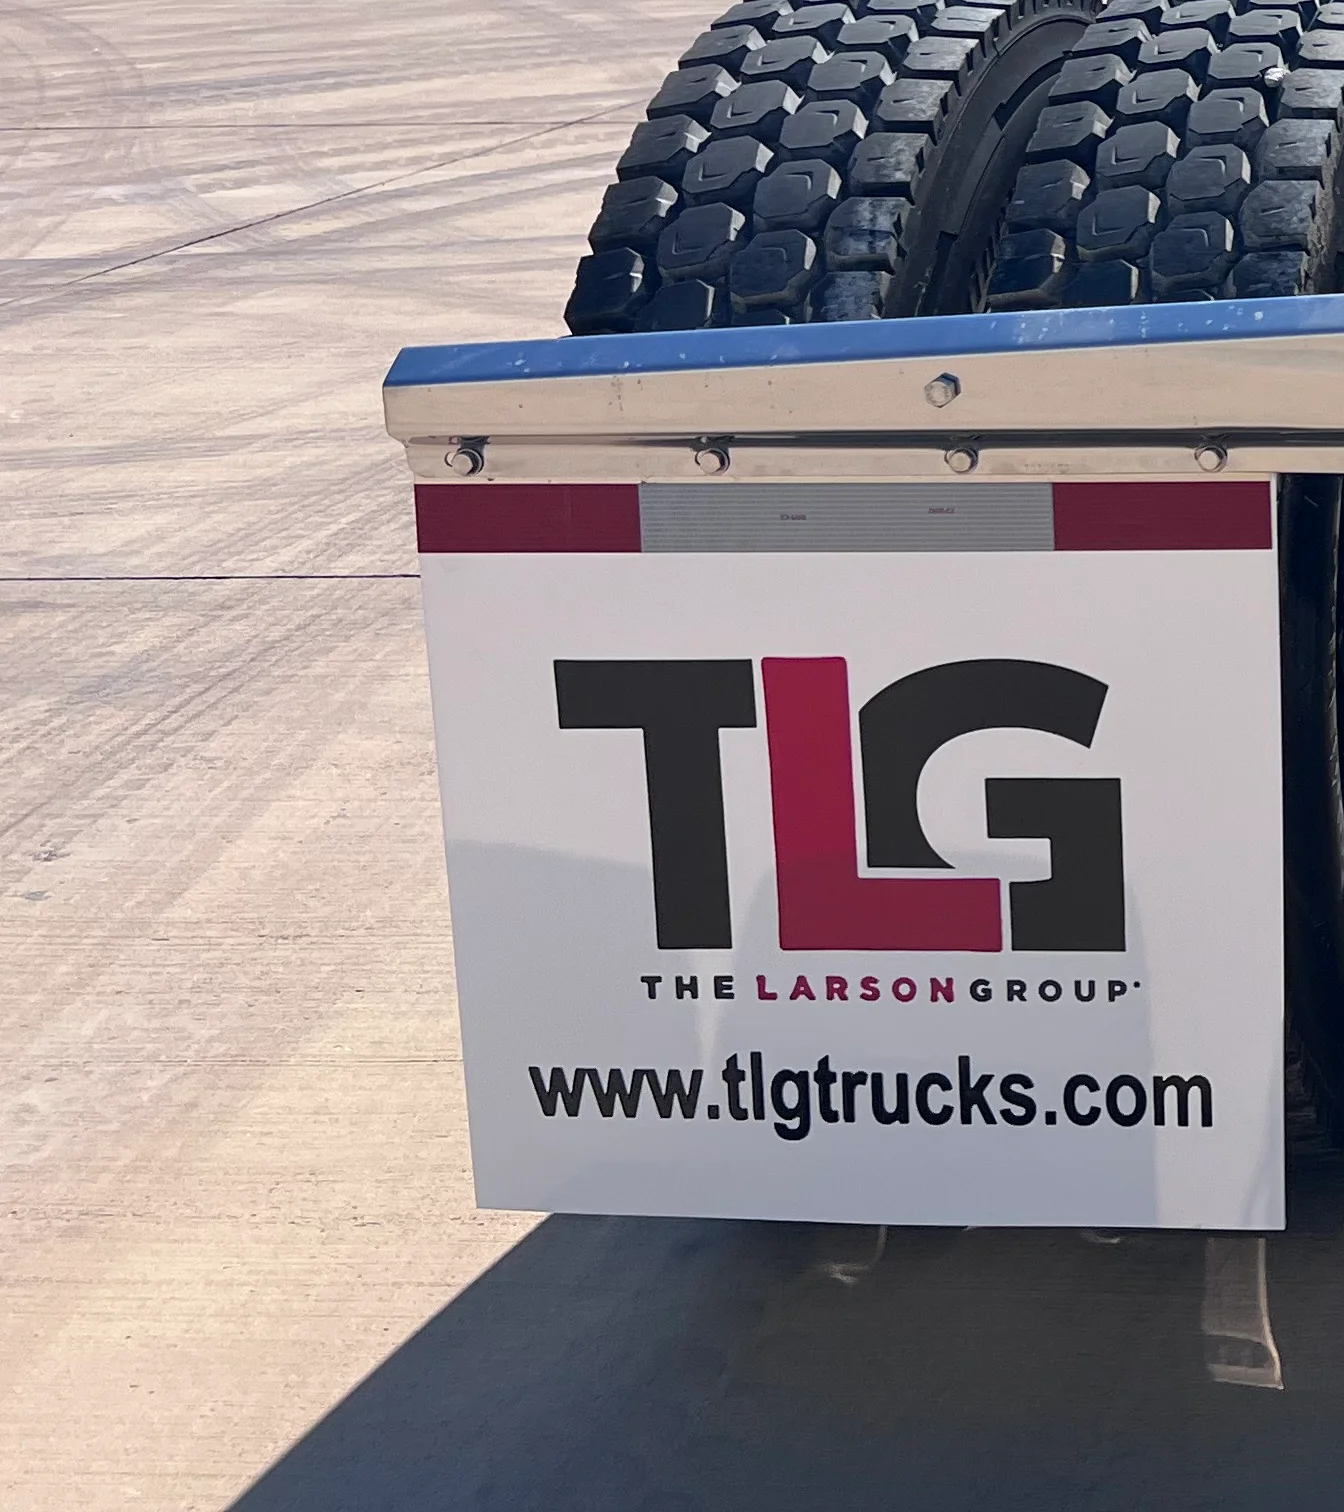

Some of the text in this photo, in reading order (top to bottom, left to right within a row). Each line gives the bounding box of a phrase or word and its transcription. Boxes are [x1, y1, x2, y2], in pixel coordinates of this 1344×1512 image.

[554, 656, 1127, 953] TLG
[640, 975, 735, 1000] THE
[755, 974, 955, 1004] LARSON
[528, 1050, 1213, 1141] www.tlgtrucks.com
